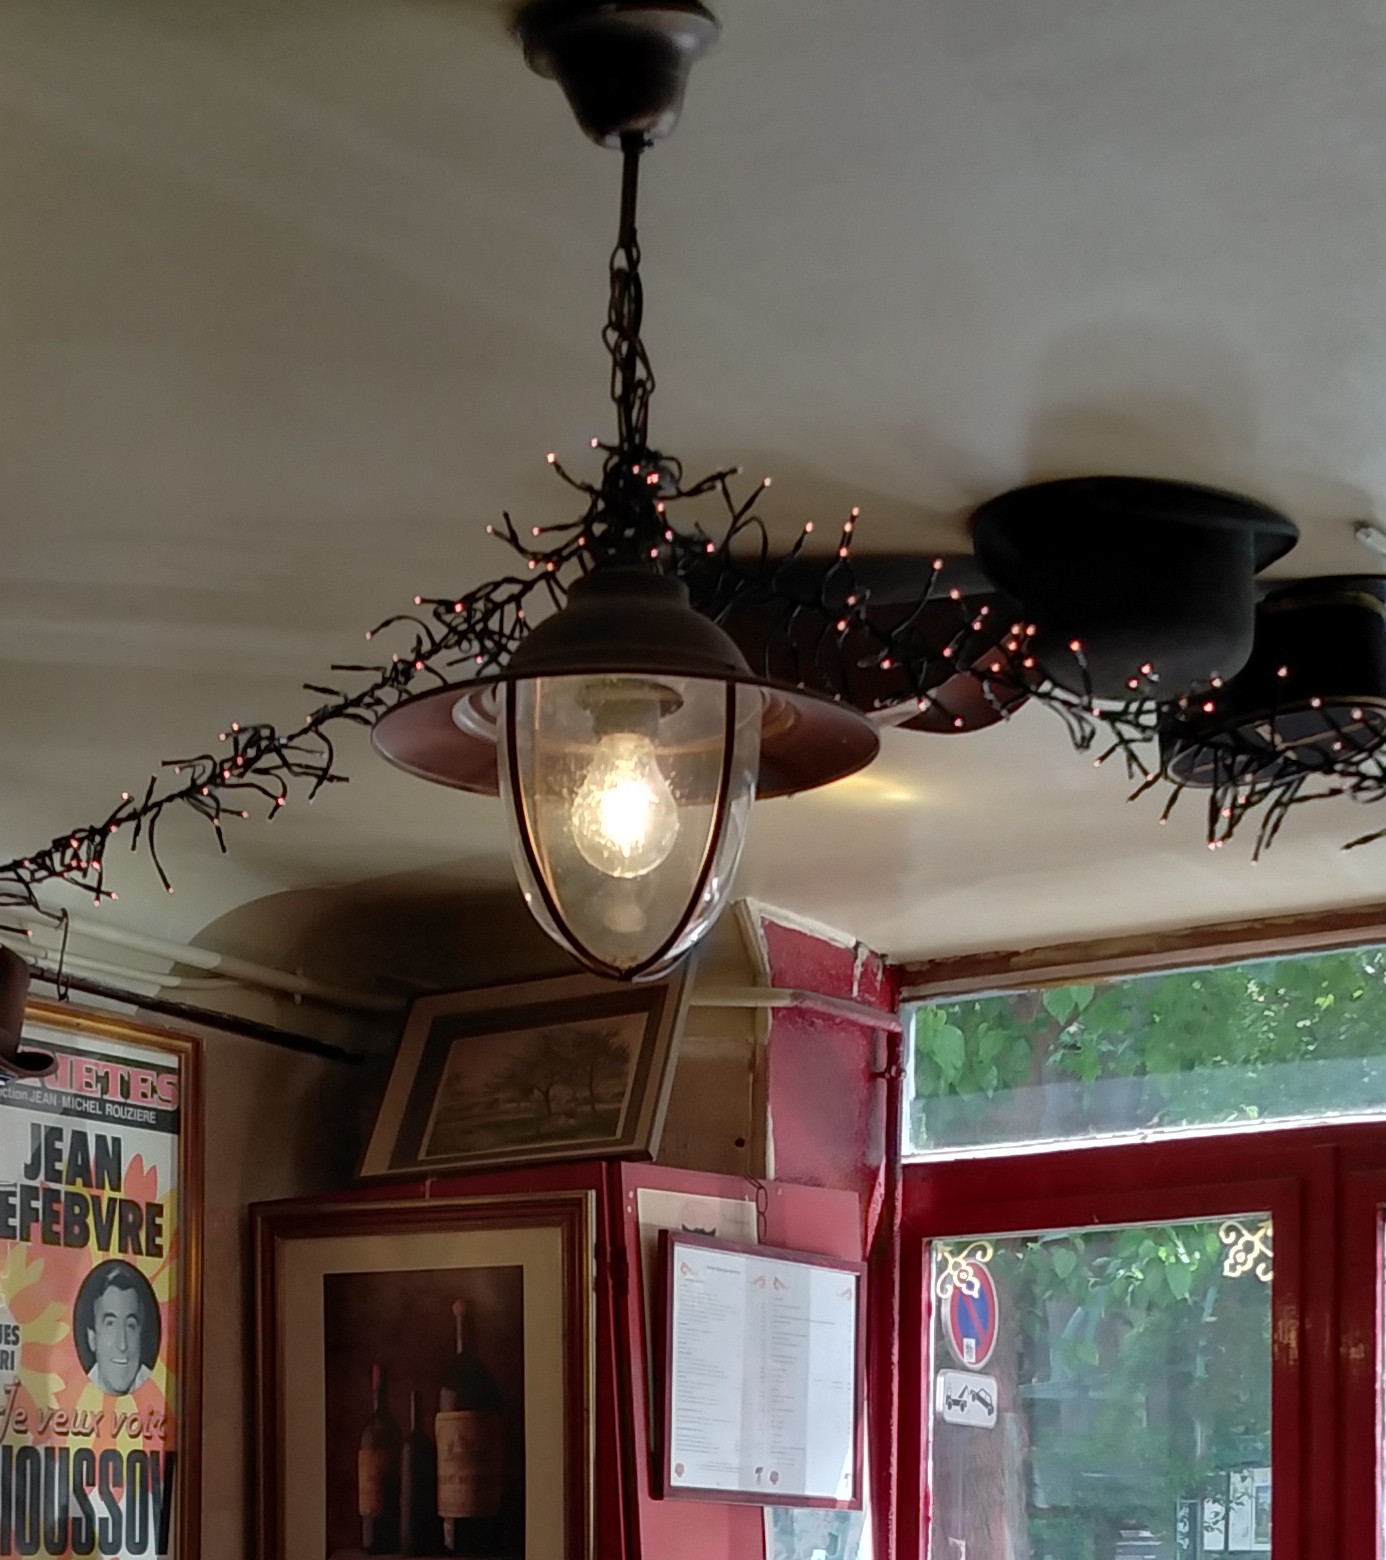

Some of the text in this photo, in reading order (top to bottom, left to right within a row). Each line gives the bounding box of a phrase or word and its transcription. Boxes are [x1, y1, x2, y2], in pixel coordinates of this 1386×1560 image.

[29, 1090, 57, 1106] JEAN
[62, 1097, 102, 1116] MICHEL
[105, 1103, 156, 1124] ROUZIERE
[24, 1123, 122, 1192] JEAN
[37, 1407, 104, 1436] veux
[112, 1407, 168, 1441] voir
